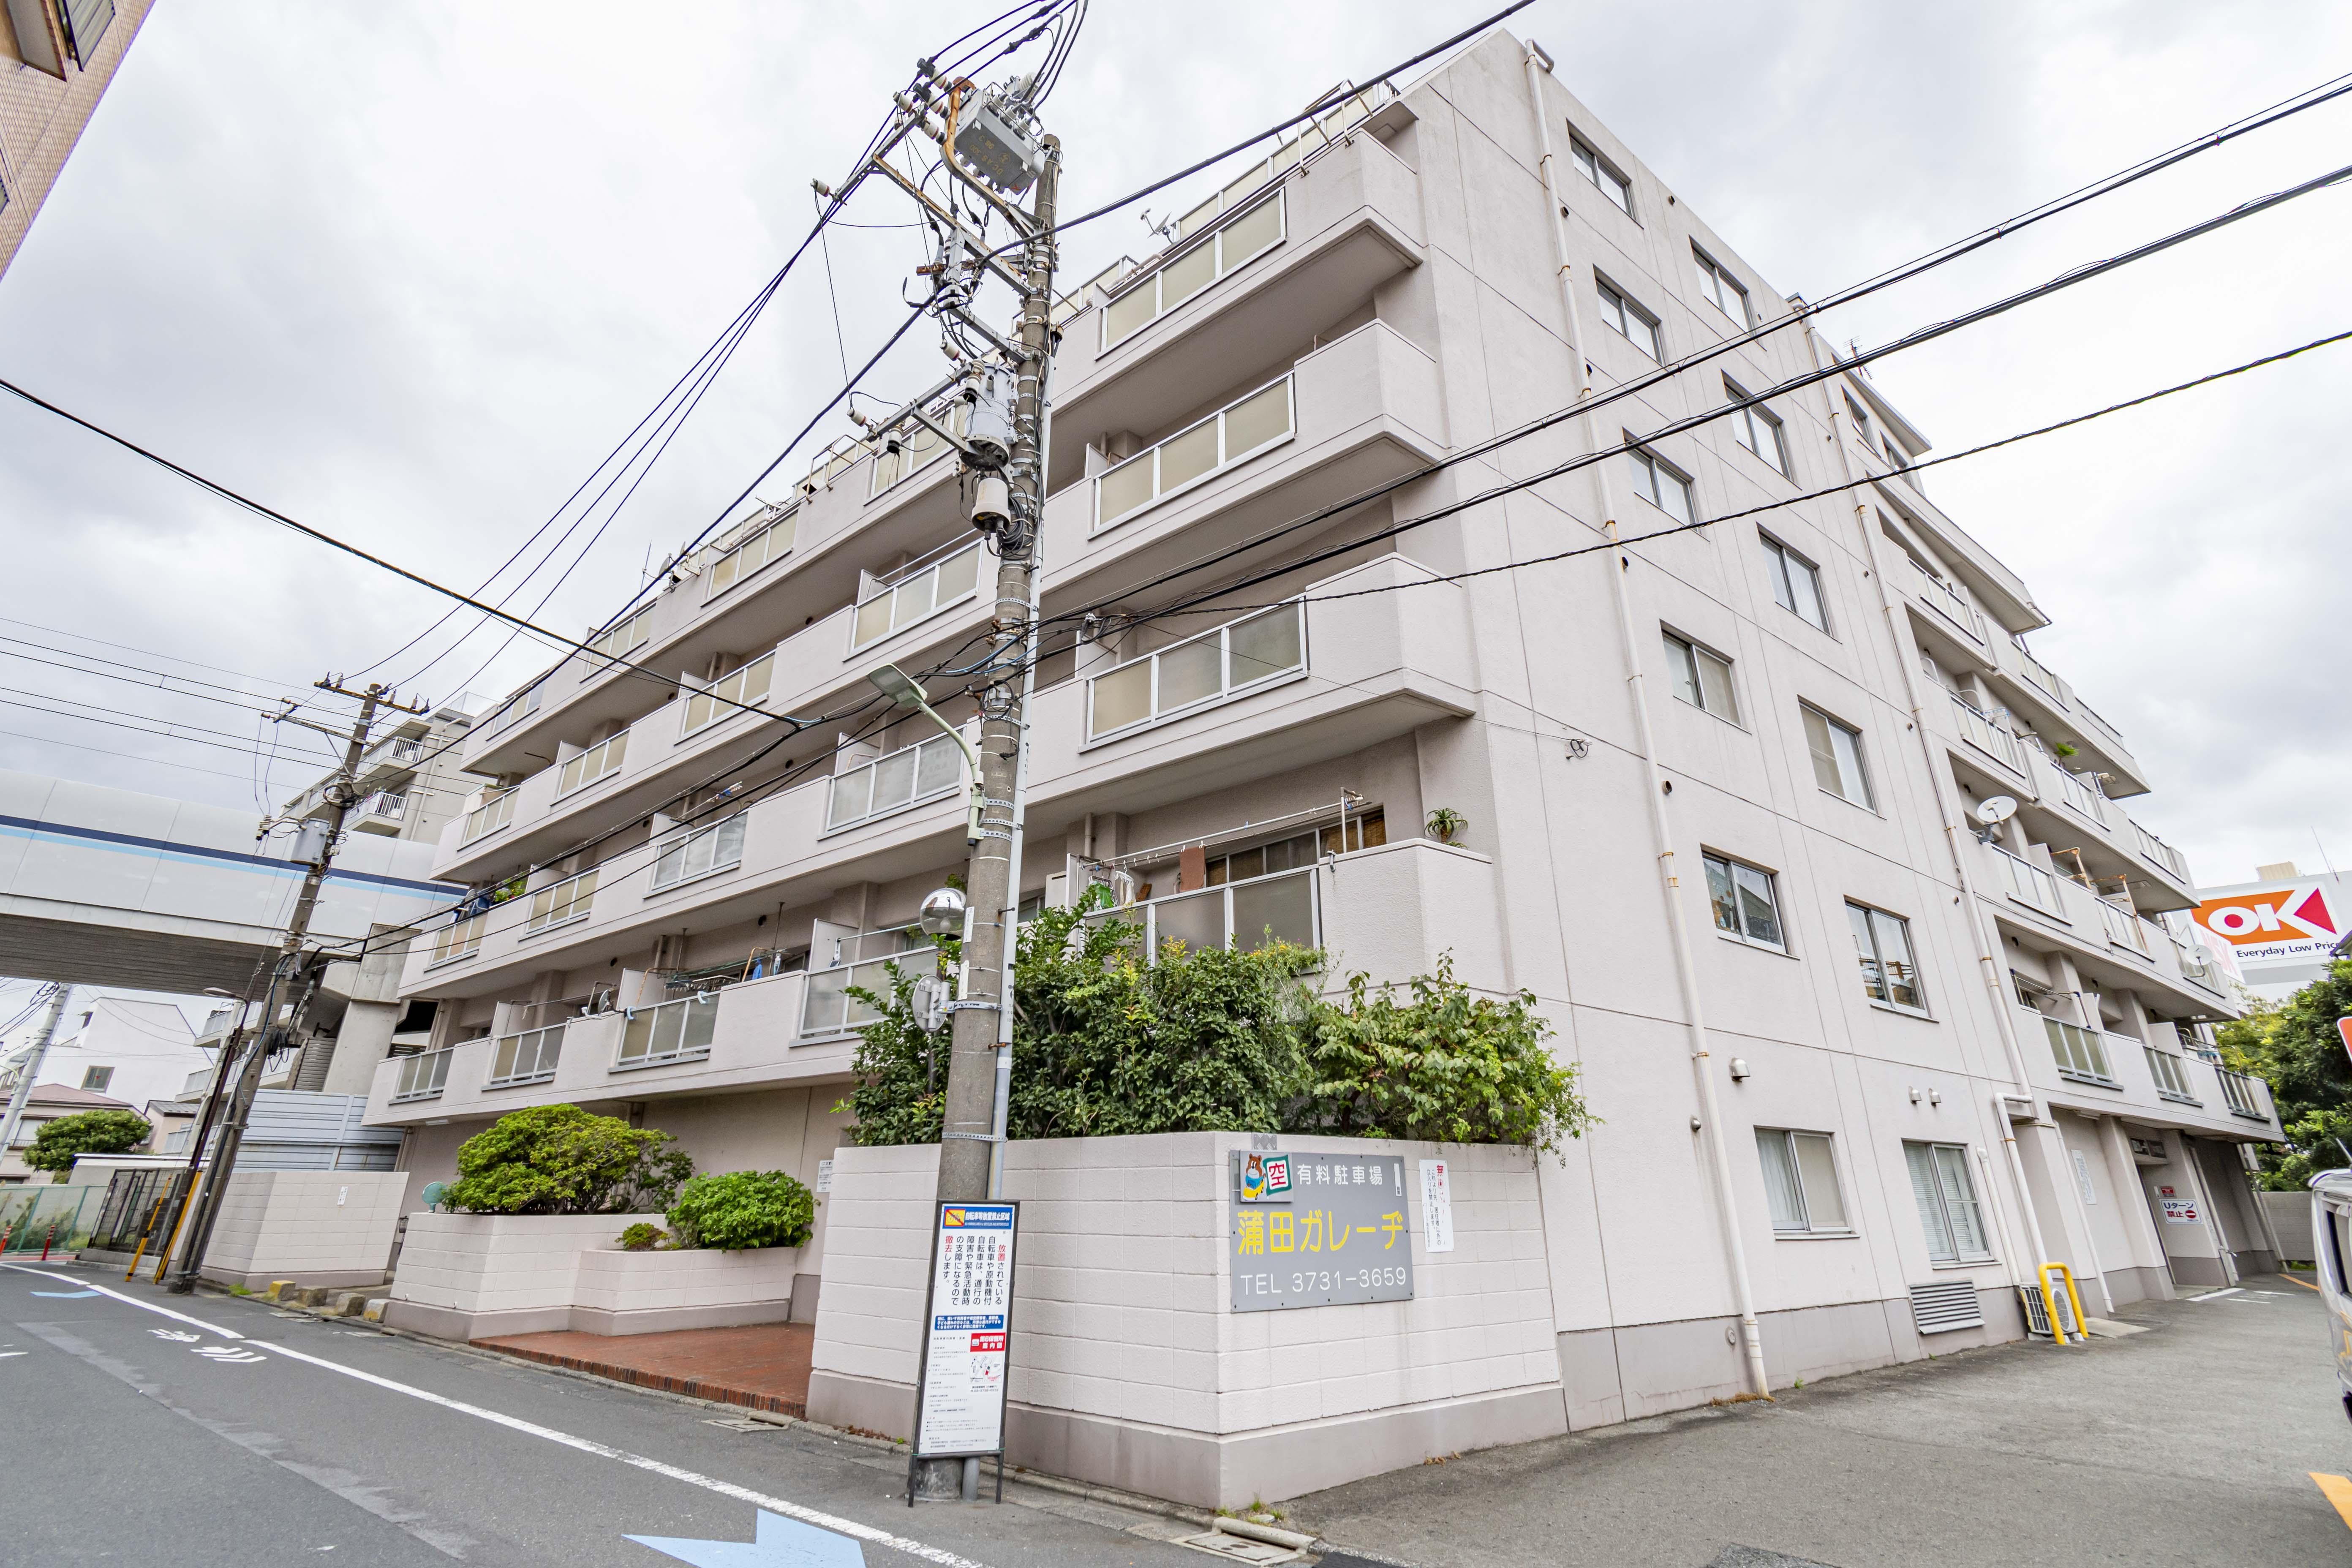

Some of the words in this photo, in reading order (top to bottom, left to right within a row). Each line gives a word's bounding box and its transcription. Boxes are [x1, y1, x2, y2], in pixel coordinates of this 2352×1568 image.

[2208, 887, 2336, 938] OK
[2236, 947, 2284, 957] Everyday
[1269, 1163, 1286, 1187] 空
[1297, 1164, 1383, 1185] 有料駐車場
[1238, 1209, 1403, 1255] 蒲田ガレーヂ
[943, 1236, 953, 1283] 撤去します。
[951, 1236, 964, 1305] の支障になるので
[962, 1235, 975, 1305] 障害や緊急活動時
[973, 1236, 985, 1305] 自転車は、通行の
[984, 1236, 996, 1305] 自転車や原動機付
[995, 1244, 1006, 1305] 放置されている
[1240, 1274, 1282, 1295] TEL
[1292, 1267, 1406, 1291] 3731-3659
